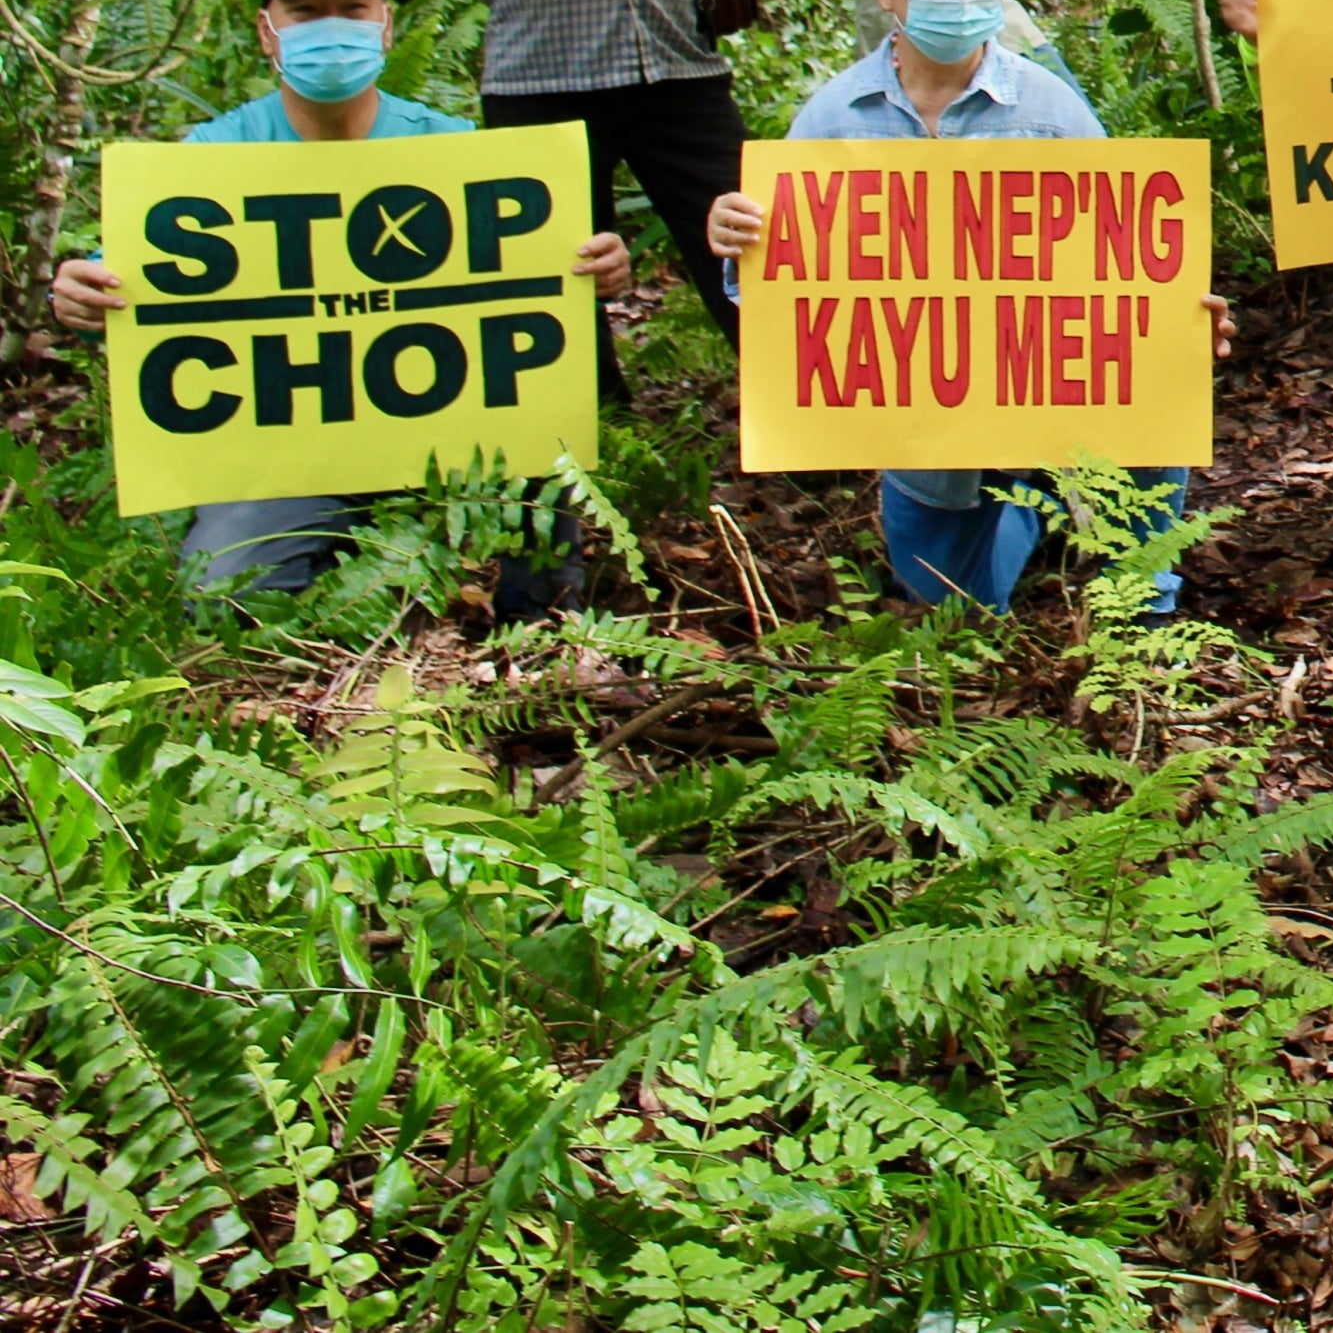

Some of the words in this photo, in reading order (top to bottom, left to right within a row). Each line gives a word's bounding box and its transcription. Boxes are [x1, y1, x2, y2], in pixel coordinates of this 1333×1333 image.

[142, 177, 552, 296] STOP
[763, 170, 930, 282] AYEN
[953, 170, 1184, 284] NEP'NG
[318, 289, 390, 318] THE
[795, 296, 970, 408] KAYU
[996, 295, 1149, 407] MEH'
[137, 311, 565, 434] CHOP
